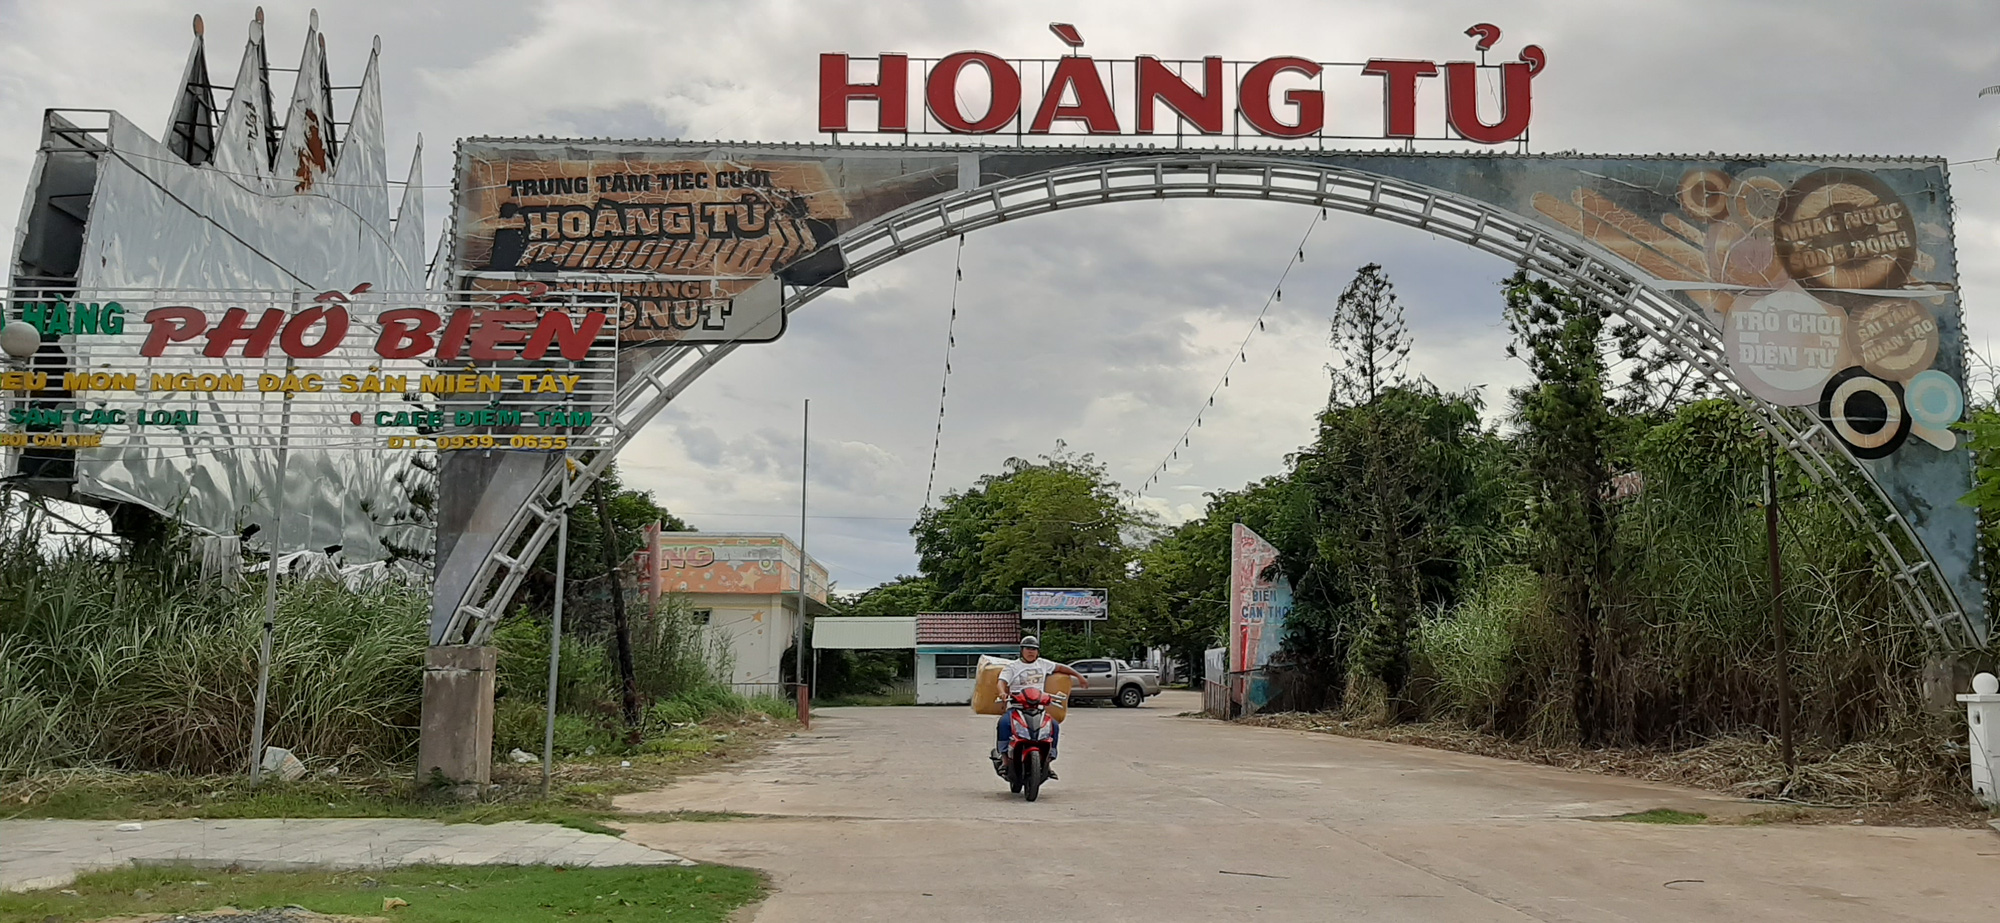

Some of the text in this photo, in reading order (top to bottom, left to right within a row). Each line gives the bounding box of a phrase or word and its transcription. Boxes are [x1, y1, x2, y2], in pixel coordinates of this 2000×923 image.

[819, 23, 1546, 144] HOÀNG TỬ
[508, 177, 589, 197] TRUNG
[596, 172, 652, 193] TÂM
[524, 193, 770, 241] HOÀNG TỬ
[22, 281, 607, 360] HÀNG PHỐ BIỂN
[1733, 306, 1780, 332] TRÒ
[1904, 318, 1934, 344] TẠO
[1739, 336, 1838, 370] ĐIỆN TỬ
[151, 372, 243, 392] NGON
[340, 366, 407, 393] SẢN
[420, 362, 501, 394] MIỀN
[517, 368, 581, 393] TÂY
[8, 400, 63, 426] SẢN
[137, 409, 199, 431] LOẠI
[374, 401, 593, 427] CAFE ĐIỂM TÂM
[509, 435, 568, 449] 0655
[661, 547, 714, 571] NG
